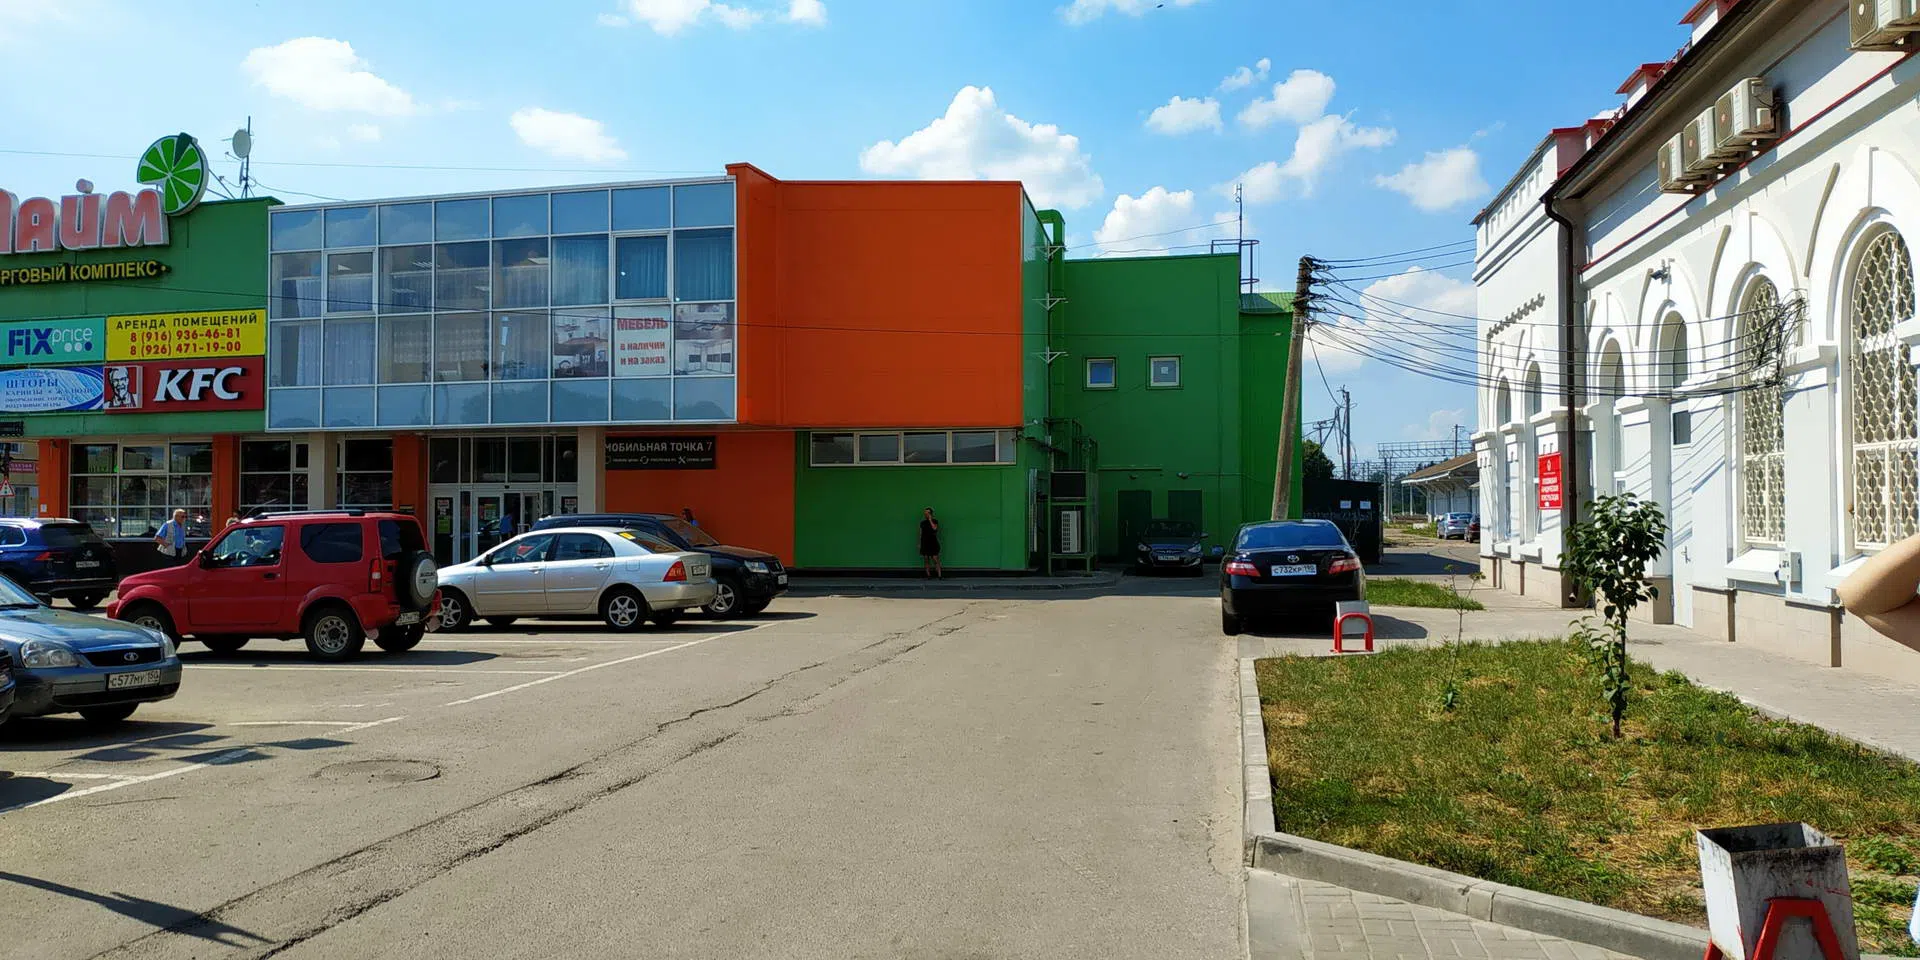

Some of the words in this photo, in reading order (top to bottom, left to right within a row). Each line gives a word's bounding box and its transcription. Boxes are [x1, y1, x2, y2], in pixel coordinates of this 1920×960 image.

[70, 260, 157, 281] КОМПЛЕКС
[116, 318, 166, 330] АРЕНДА
[173, 312, 257, 327] ПОМЕЩЕНИЙ
[617, 318, 668, 330] МЕБЕЛЬ
[52, 327, 92, 344] price
[130, 332, 137, 343] 8
[141, 330, 172, 344] (916)
[176, 328, 241, 340] 936-46-81
[130, 345, 137, 356] 8
[140, 343, 172, 356] (926)
[176, 341, 241, 354] 471-19-00
[627, 341, 665, 351] наличии
[627, 357, 639, 366] на
[640, 355, 666, 365] заказ
[6, 379, 58, 388] ШТОРЫ
[153, 366, 243, 402] KFC
[605, 442, 667, 452] МОБИЛЬНАЯ
[670, 442, 704, 452] ТОЧКА
[706, 441, 713, 451] 7
